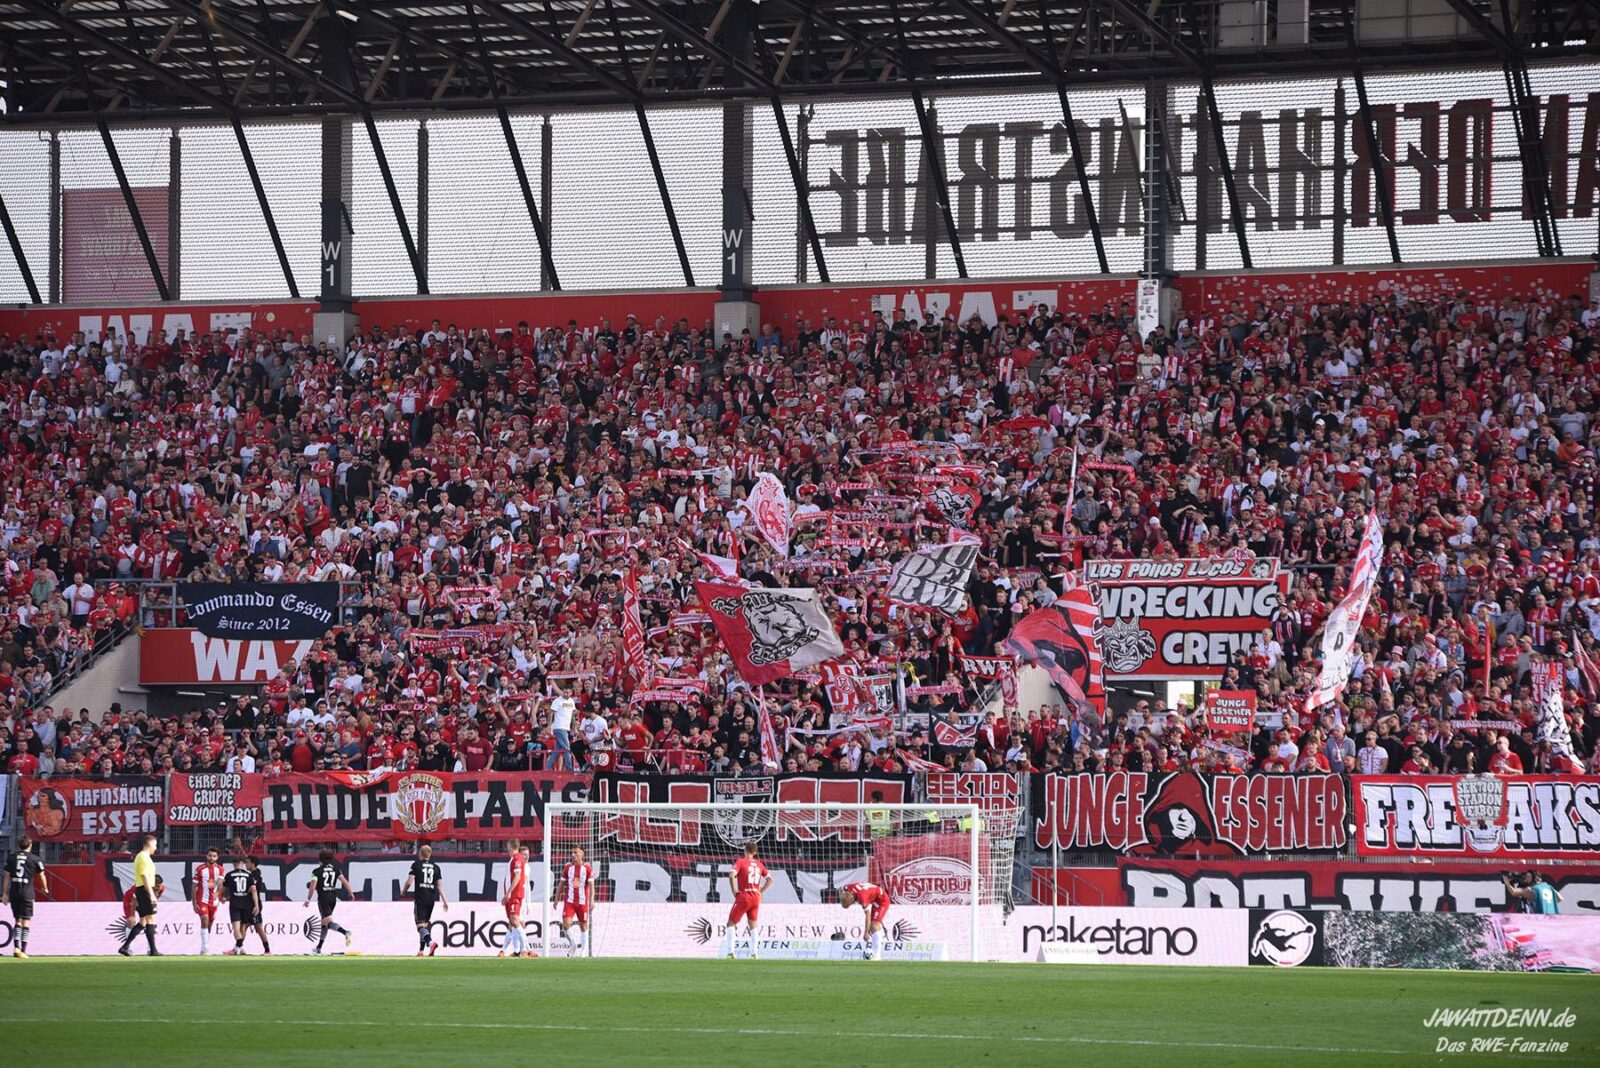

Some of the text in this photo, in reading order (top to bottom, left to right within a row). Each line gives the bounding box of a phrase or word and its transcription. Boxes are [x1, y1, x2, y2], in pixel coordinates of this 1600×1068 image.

[722, 229, 743, 248] W
[322, 241, 341, 260] W
[727, 252, 736, 275] 1
[326, 264, 334, 286] 1
[1090, 563, 1123, 578] LOS
[185, 591, 332, 624] Commando Essen
[216, 616, 291, 630] Since 2012
[1215, 699, 1247, 707] JUNGE
[1210, 707, 1252, 716] ESSENER
[1213, 716, 1249, 725] ULTRAS
[188, 774, 242, 789] EHRE DER
[926, 773, 1020, 796] SEKTION
[1458, 781, 1503, 794] SEKTION
[193, 790, 234, 805] GRUPPE
[268, 780, 592, 831] RUDE FANS
[1458, 793, 1503, 806] STADION
[1036, 772, 1346, 851] JUNGE ESSENER
[1461, 804, 1501, 817] VERBOT
[82, 809, 157, 835] ESSEN
[16, 860, 25, 877] 5
[422, 868, 434, 884] 13
[234, 877, 247, 892] 10
[322, 871, 336, 887] 27
[884, 872, 985, 899] WESTTRIBÜN
[785, 924, 824, 938] NEW
[1022, 915, 1198, 956] naketano
[842, 941, 935, 951] GARENBAU
